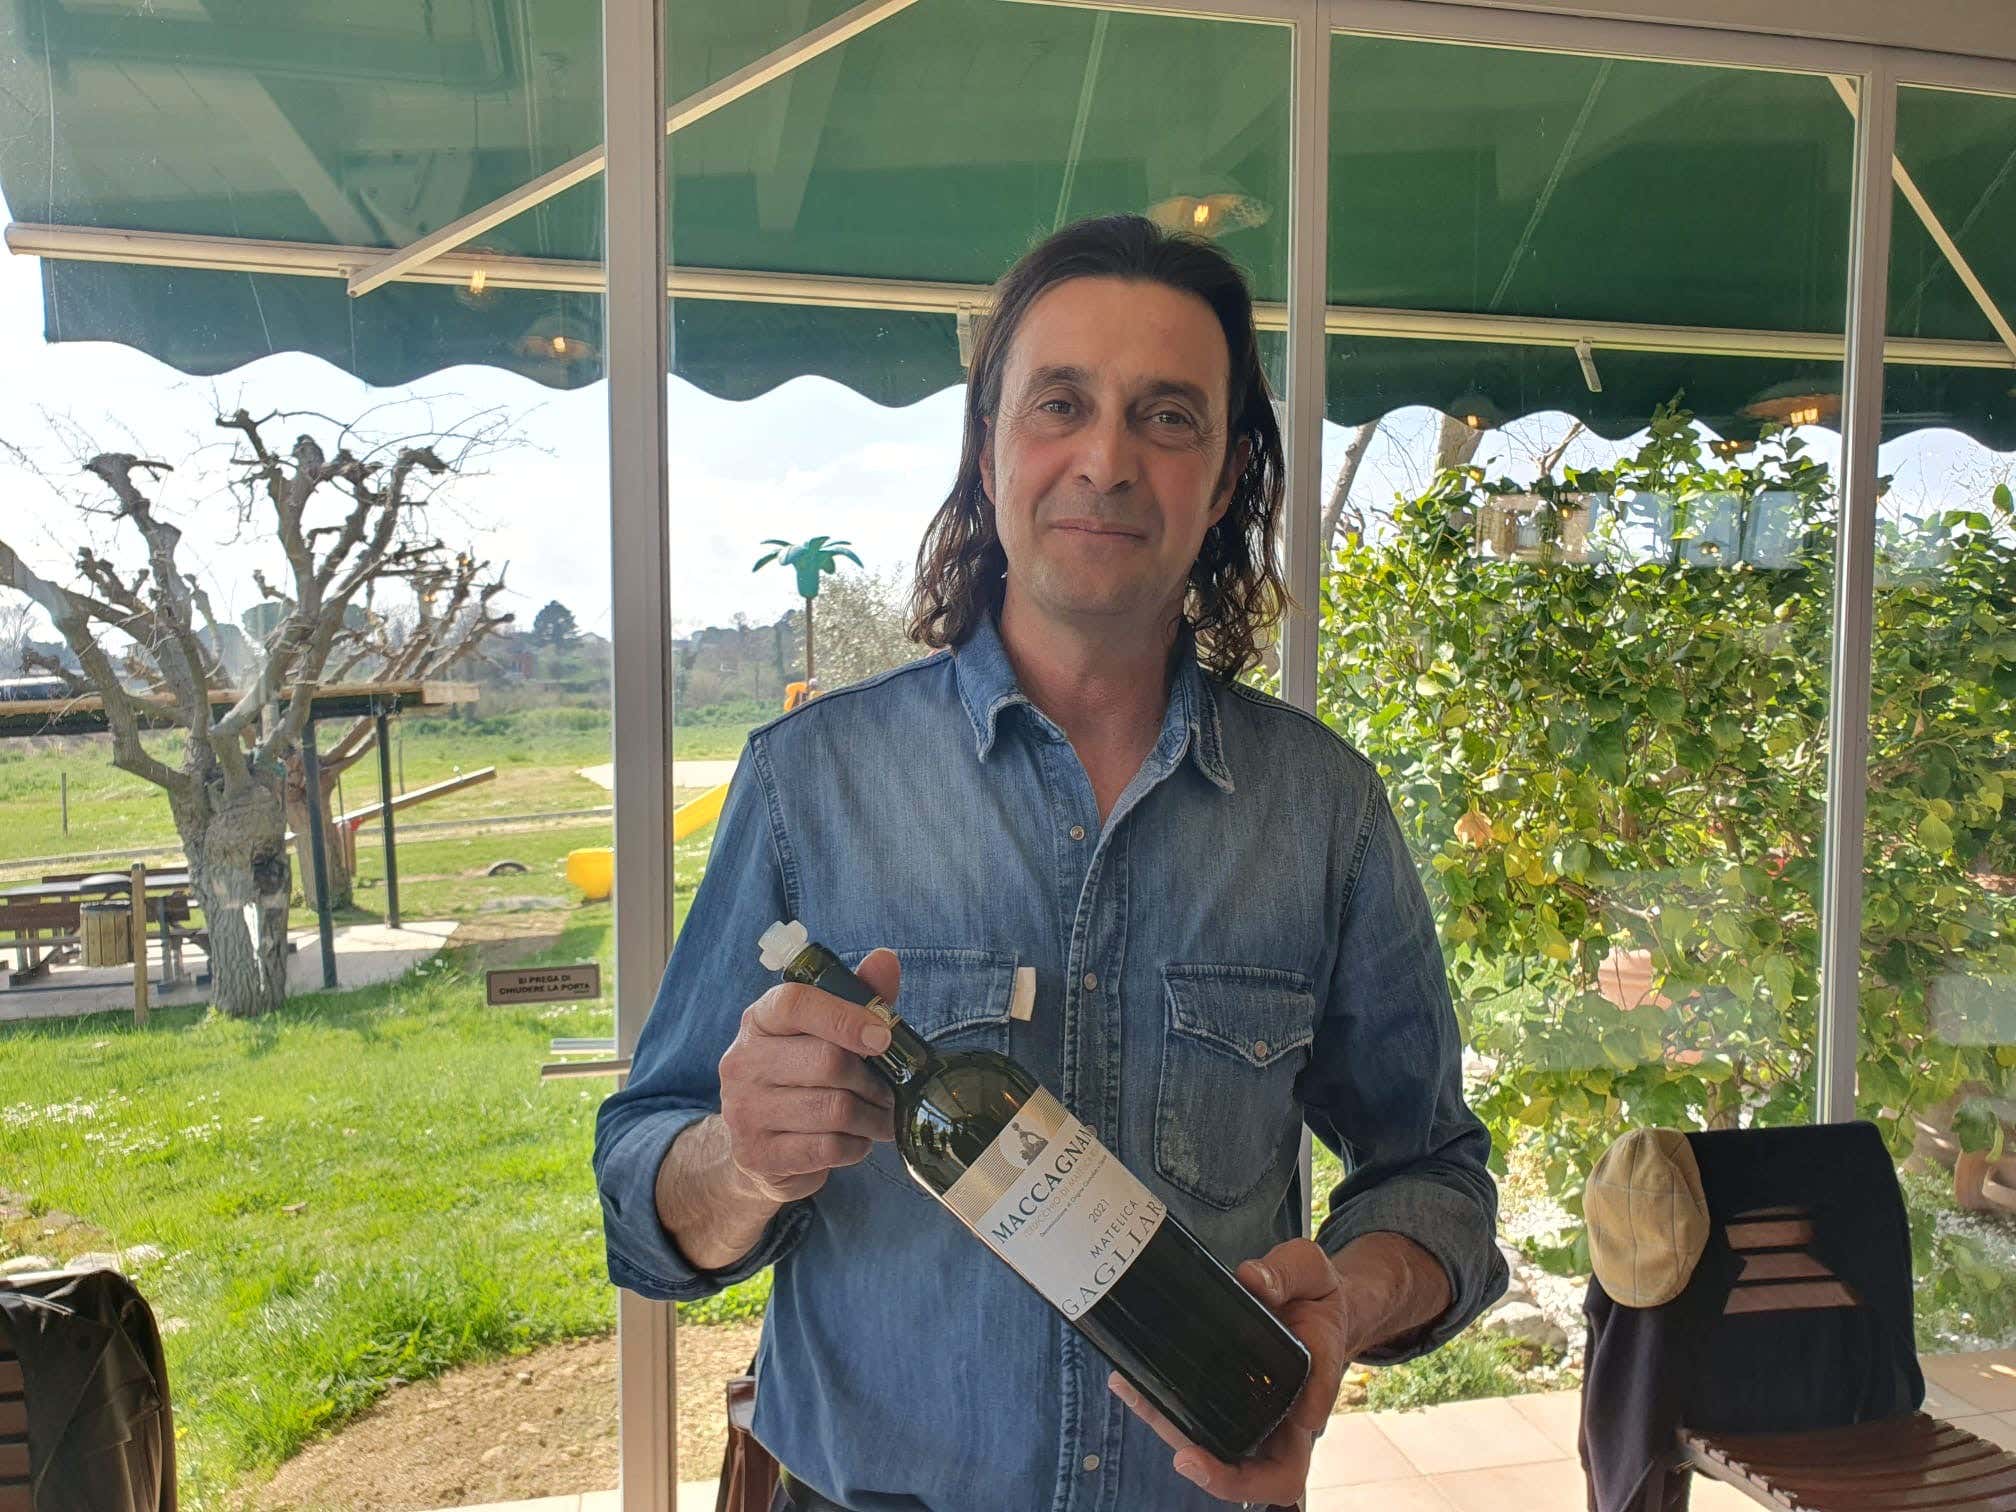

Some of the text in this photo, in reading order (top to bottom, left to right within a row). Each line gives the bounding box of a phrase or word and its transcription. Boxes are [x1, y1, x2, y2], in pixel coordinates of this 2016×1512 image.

[529, 975, 558, 984] PREGA
[499, 985, 545, 995] CHIUDERE
[561, 983, 591, 991] PORTA
[1088, 1198, 1110, 1223] 2021
[1090, 1200, 1139, 1259] MATELICA
